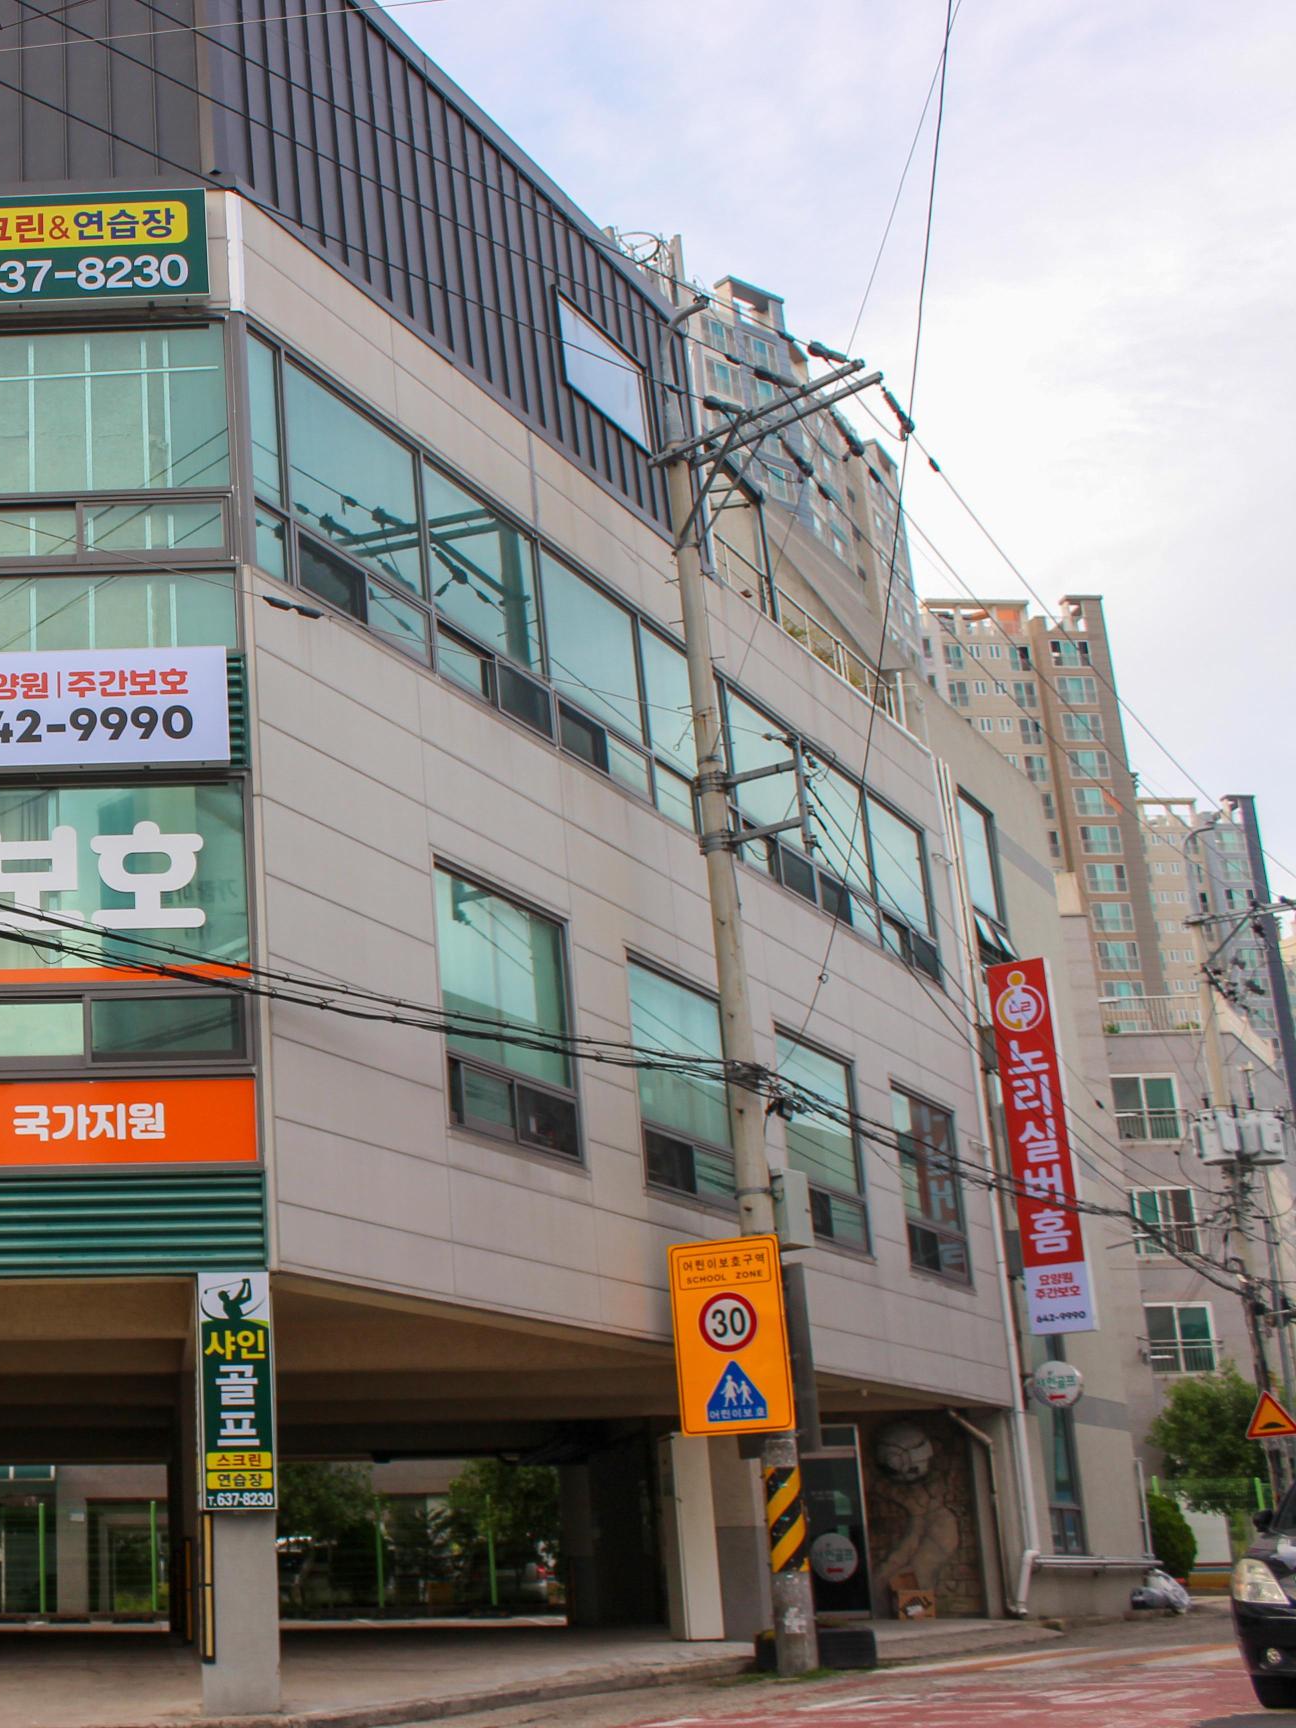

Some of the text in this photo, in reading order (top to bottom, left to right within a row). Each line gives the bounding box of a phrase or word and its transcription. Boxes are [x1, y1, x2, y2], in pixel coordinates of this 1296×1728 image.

[67, 669, 189, 698] 주간보호
[13, 1103, 167, 1141] 국가지원
[1008, 1040, 1072, 1254] 노리실버홈
[683, 1253, 765, 1272] 어린이보호구역
[687, 1270, 763, 1285] SCHOOL ZONE
[712, 1307, 746, 1338] 30
[1037, 1310, 1086, 1323] 642-9990
[205, 1329, 267, 1361] 샤인
[215, 1364, 261, 1447] 골프
[216, 1454, 262, 1468] 스크린
[217, 1473, 264, 1488] 연습장
